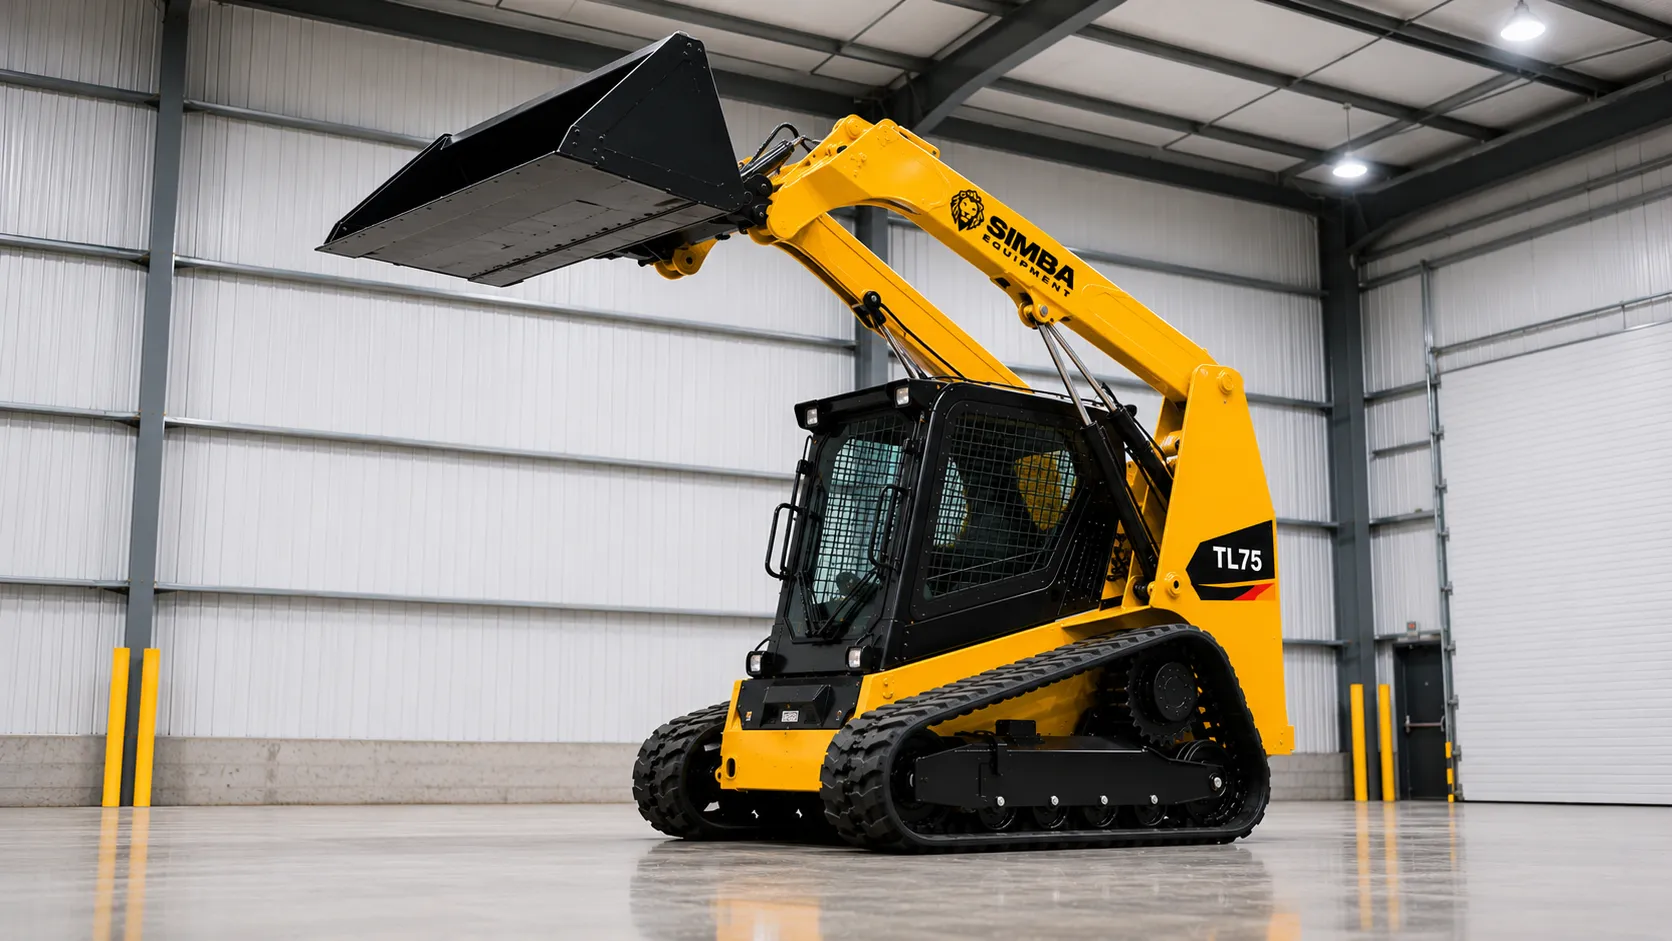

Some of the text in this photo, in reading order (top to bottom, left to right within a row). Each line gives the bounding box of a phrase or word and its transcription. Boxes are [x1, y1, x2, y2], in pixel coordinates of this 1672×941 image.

[982, 233, 1071, 297] EQUIPMENT
[986, 215, 1075, 290] SIMBA
[1212, 545, 1263, 572] TL75
